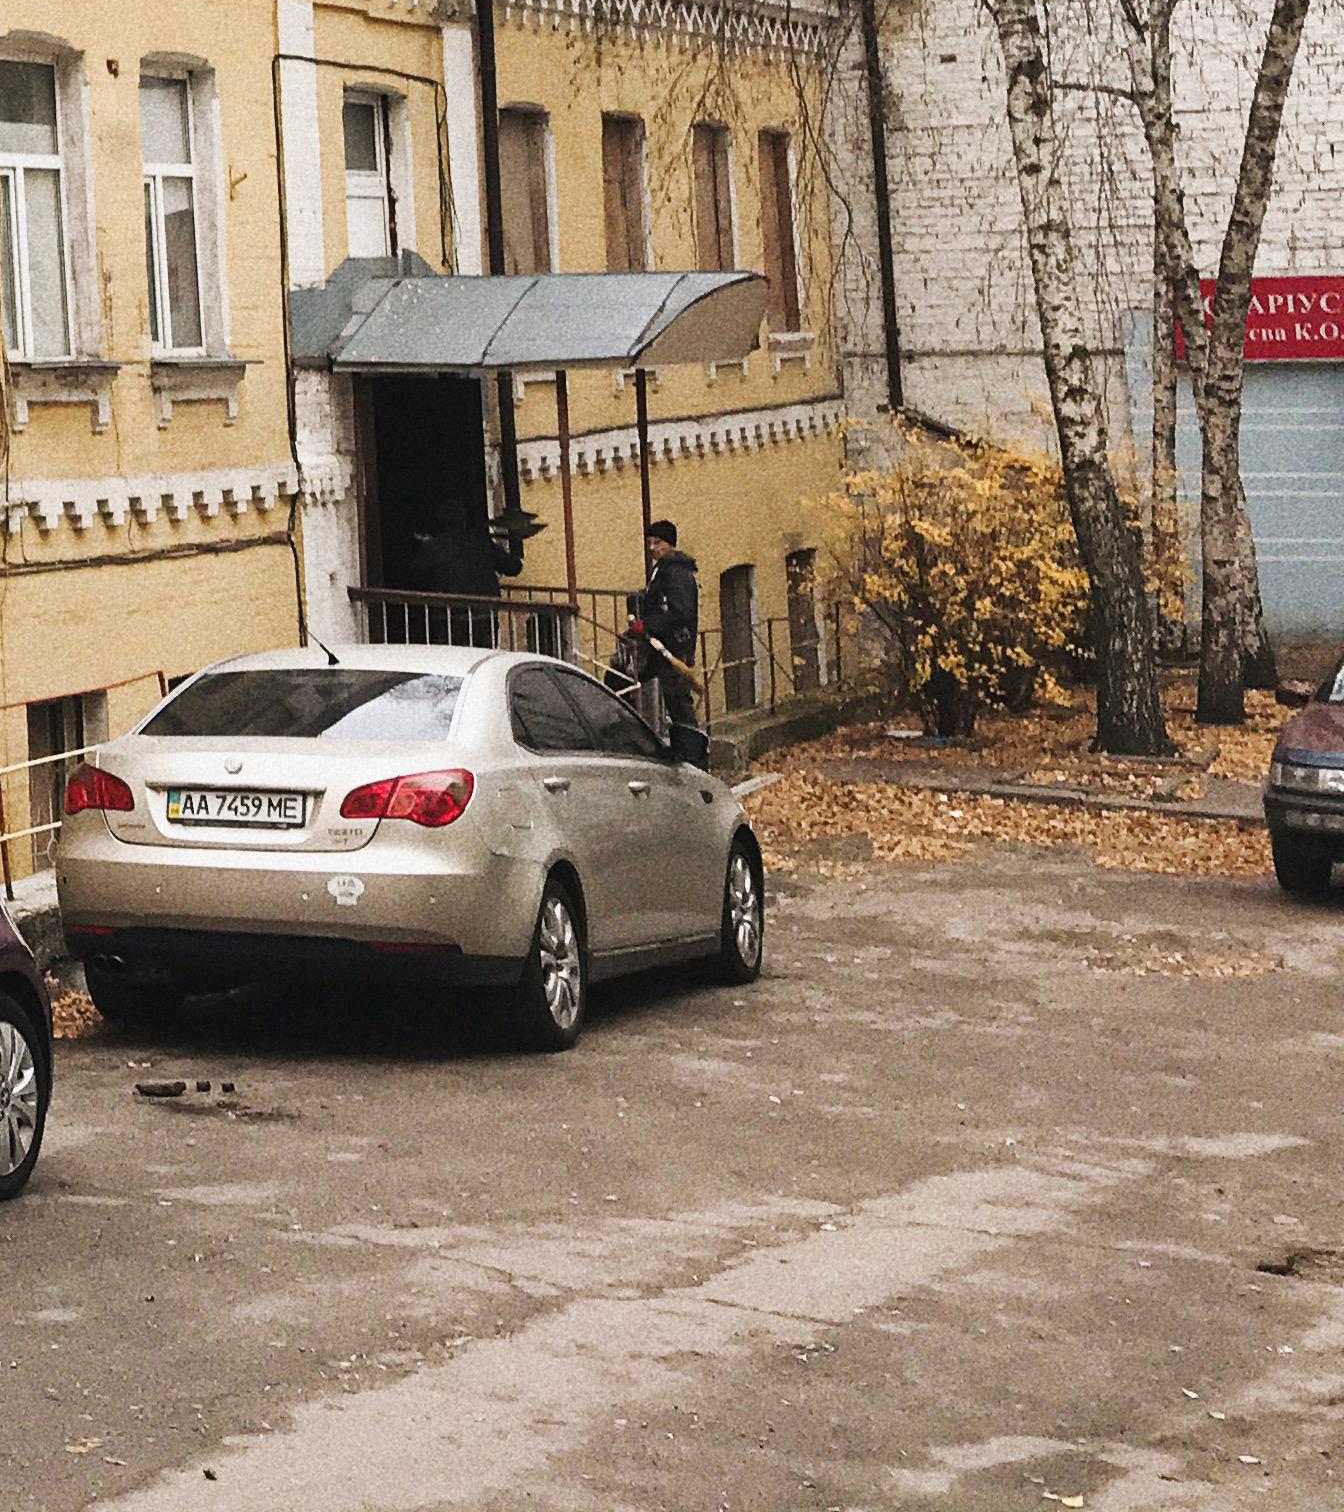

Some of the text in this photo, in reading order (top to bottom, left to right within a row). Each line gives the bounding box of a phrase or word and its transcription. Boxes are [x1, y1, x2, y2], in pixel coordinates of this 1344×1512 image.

[1203, 292, 1341, 316] АРІУС
[181, 794, 298, 819] AA 7459 ME
